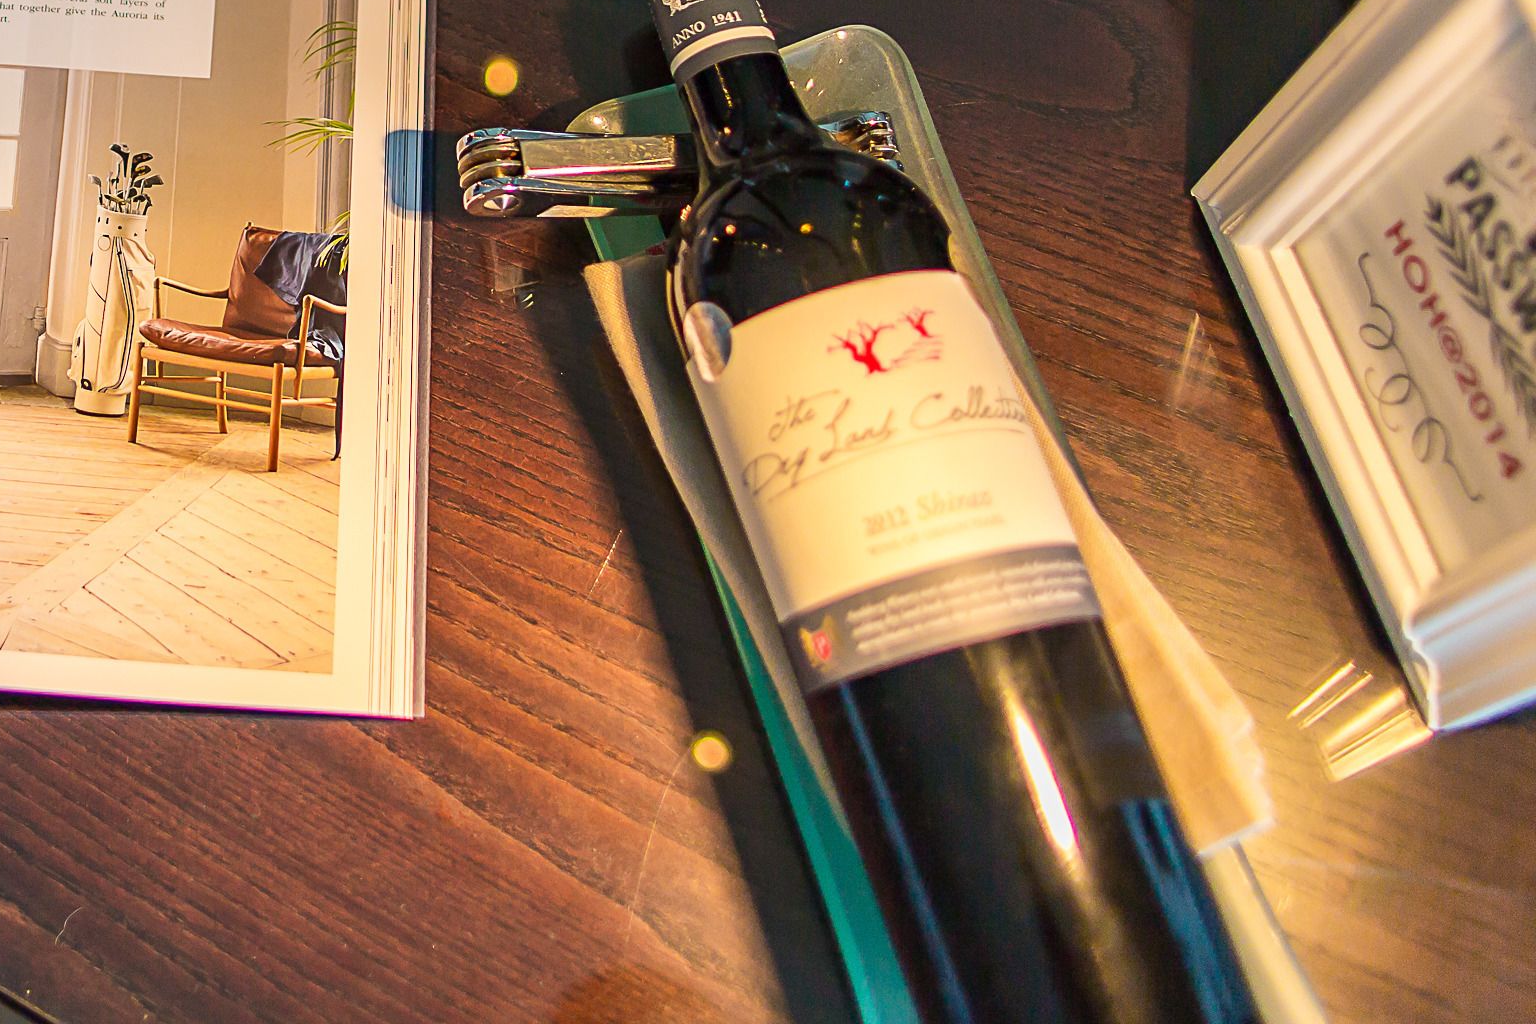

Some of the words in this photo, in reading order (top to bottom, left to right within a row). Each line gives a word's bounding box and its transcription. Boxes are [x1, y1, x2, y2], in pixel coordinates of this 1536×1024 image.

[18, 3, 60, 15] together
[64, 7, 86, 16] give
[90, 8, 106, 16] the
[111, 9, 148, 18] Auroria
[155, 0, 166, 7] of
[671, 20, 706, 49] ANNO
[711, 10, 742, 26] 1941
